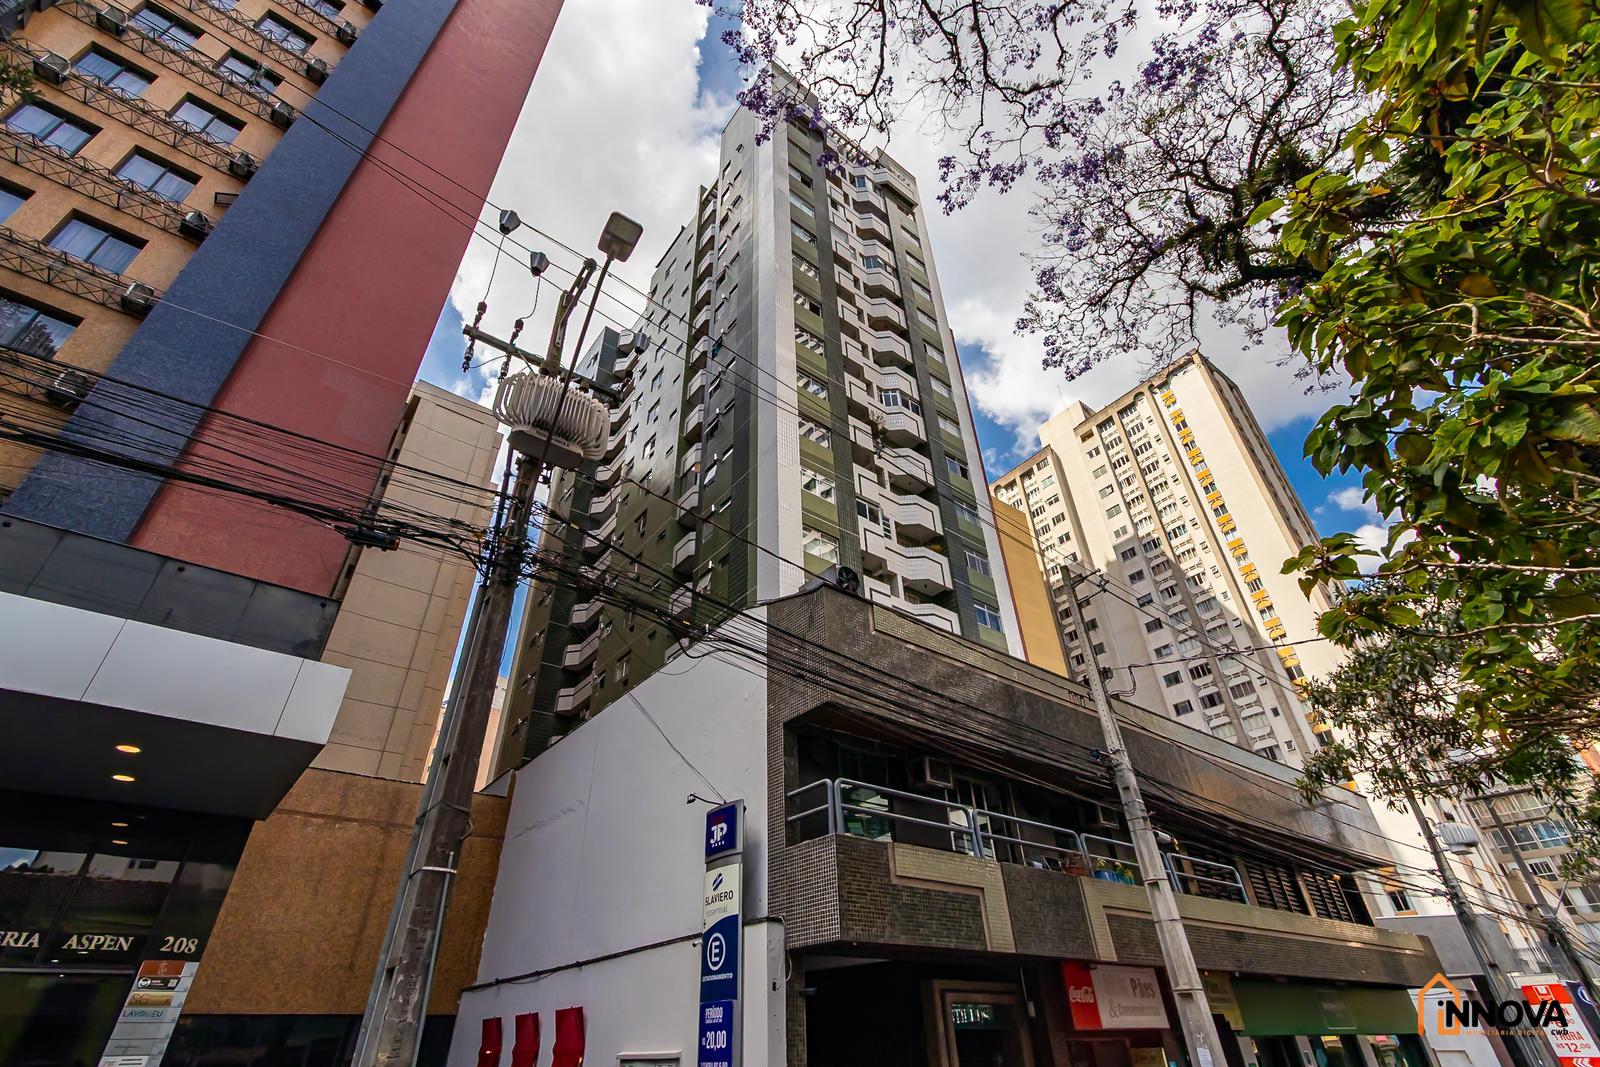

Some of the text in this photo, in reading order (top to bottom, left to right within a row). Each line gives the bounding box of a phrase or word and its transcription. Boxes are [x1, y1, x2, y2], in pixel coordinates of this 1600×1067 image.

[710, 822, 728, 844] JP
[705, 890, 734, 907] SLAVIERO
[62, 934, 134, 951] ASPEN
[160, 936, 199, 954] 208
[711, 941, 720, 962] E
[1130, 977, 1156, 999] Pães
[706, 1030, 727, 1052] 20,00
